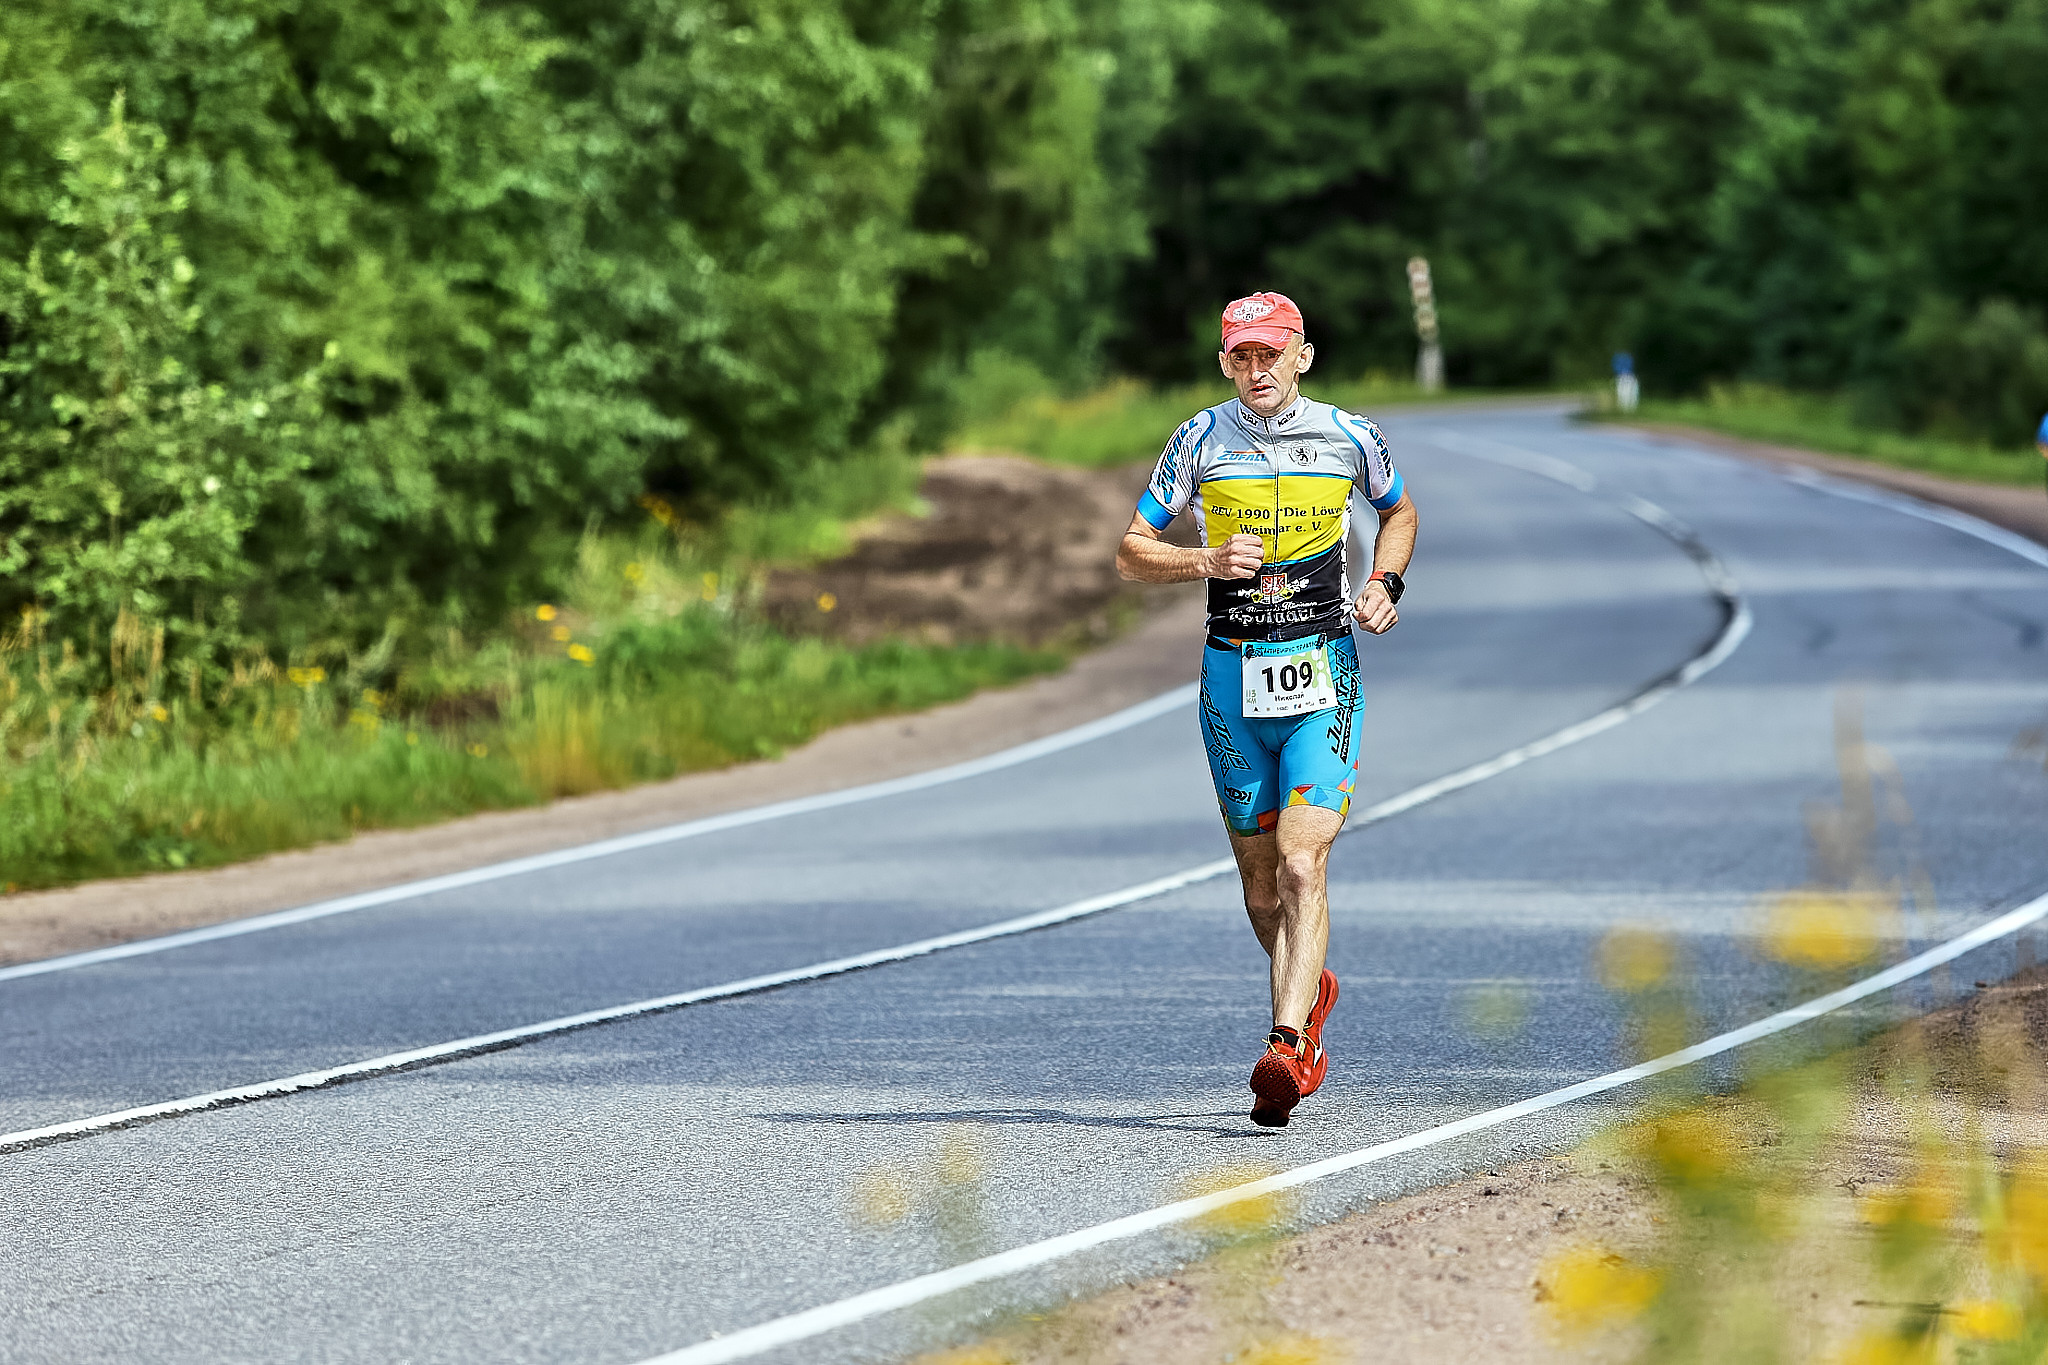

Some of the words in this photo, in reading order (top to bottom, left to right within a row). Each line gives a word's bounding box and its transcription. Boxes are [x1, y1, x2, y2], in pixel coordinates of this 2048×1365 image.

[1236, 509, 1270, 520] 1990
[1312, 521, 1322, 531] V.
[1261, 661, 1313, 693] 109
